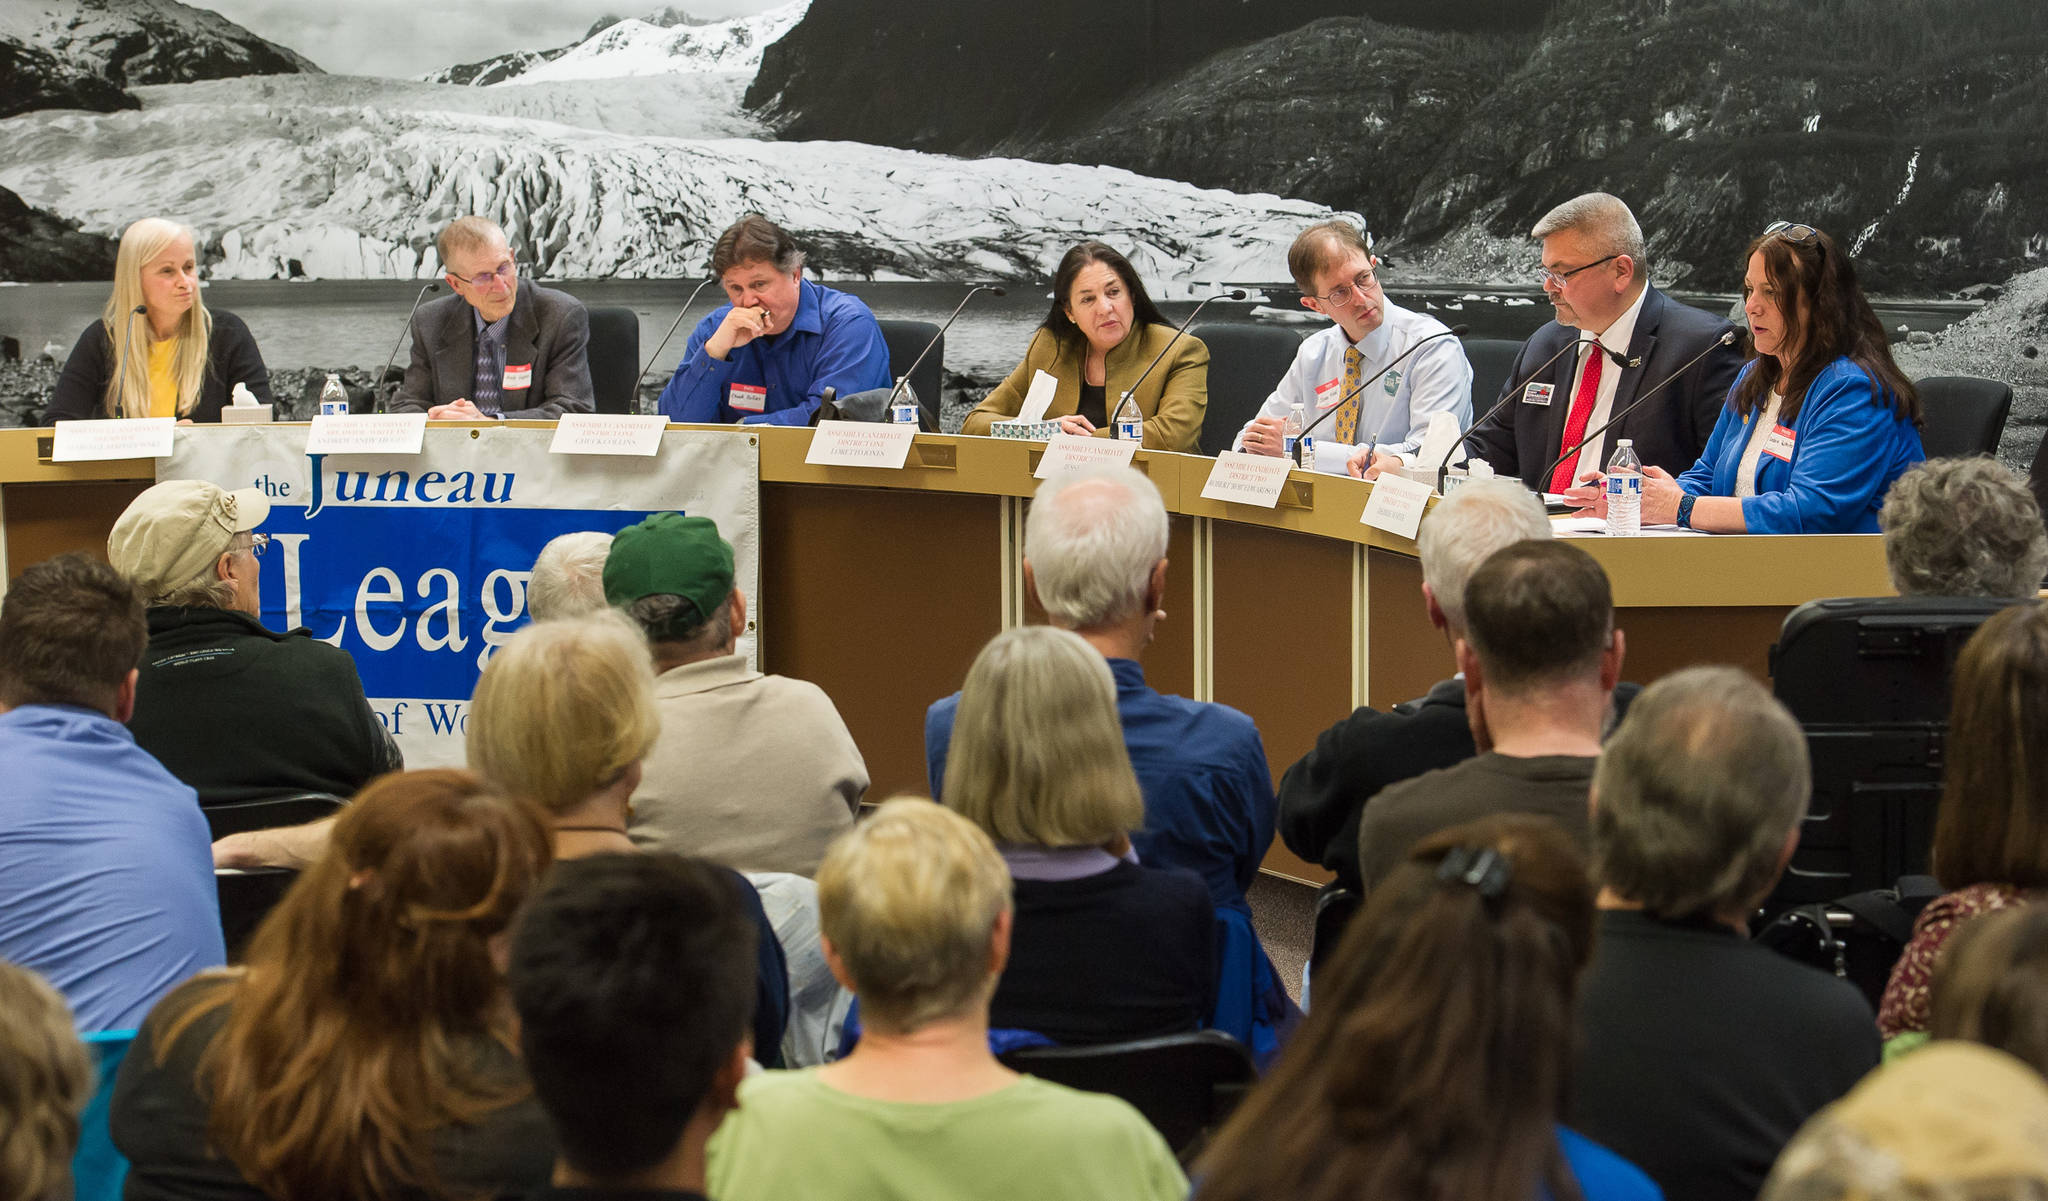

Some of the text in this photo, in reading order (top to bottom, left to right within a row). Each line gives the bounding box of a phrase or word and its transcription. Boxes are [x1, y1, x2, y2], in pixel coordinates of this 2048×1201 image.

[862, 431, 902, 440] CANDIDATE
[253, 453, 515, 520] the Juneau
